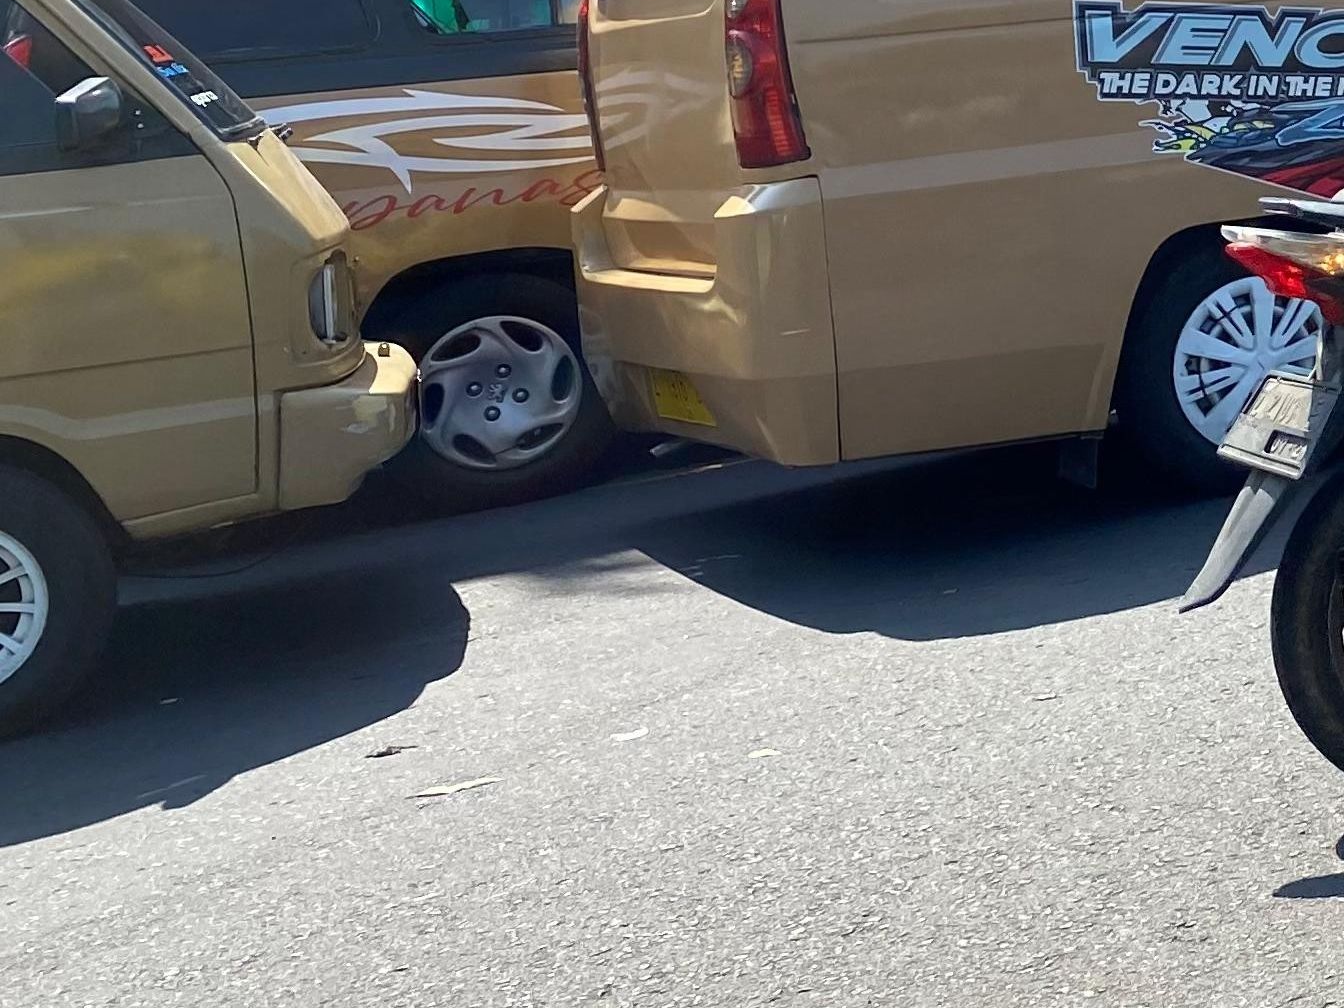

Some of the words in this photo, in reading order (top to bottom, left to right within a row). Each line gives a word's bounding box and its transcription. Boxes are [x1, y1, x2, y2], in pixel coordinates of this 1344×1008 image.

[1100, 72, 1151, 97] THE
[1154, 73, 1243, 97] DARK
[1247, 75, 1282, 97] IN
[1285, 75, 1333, 98] THE
